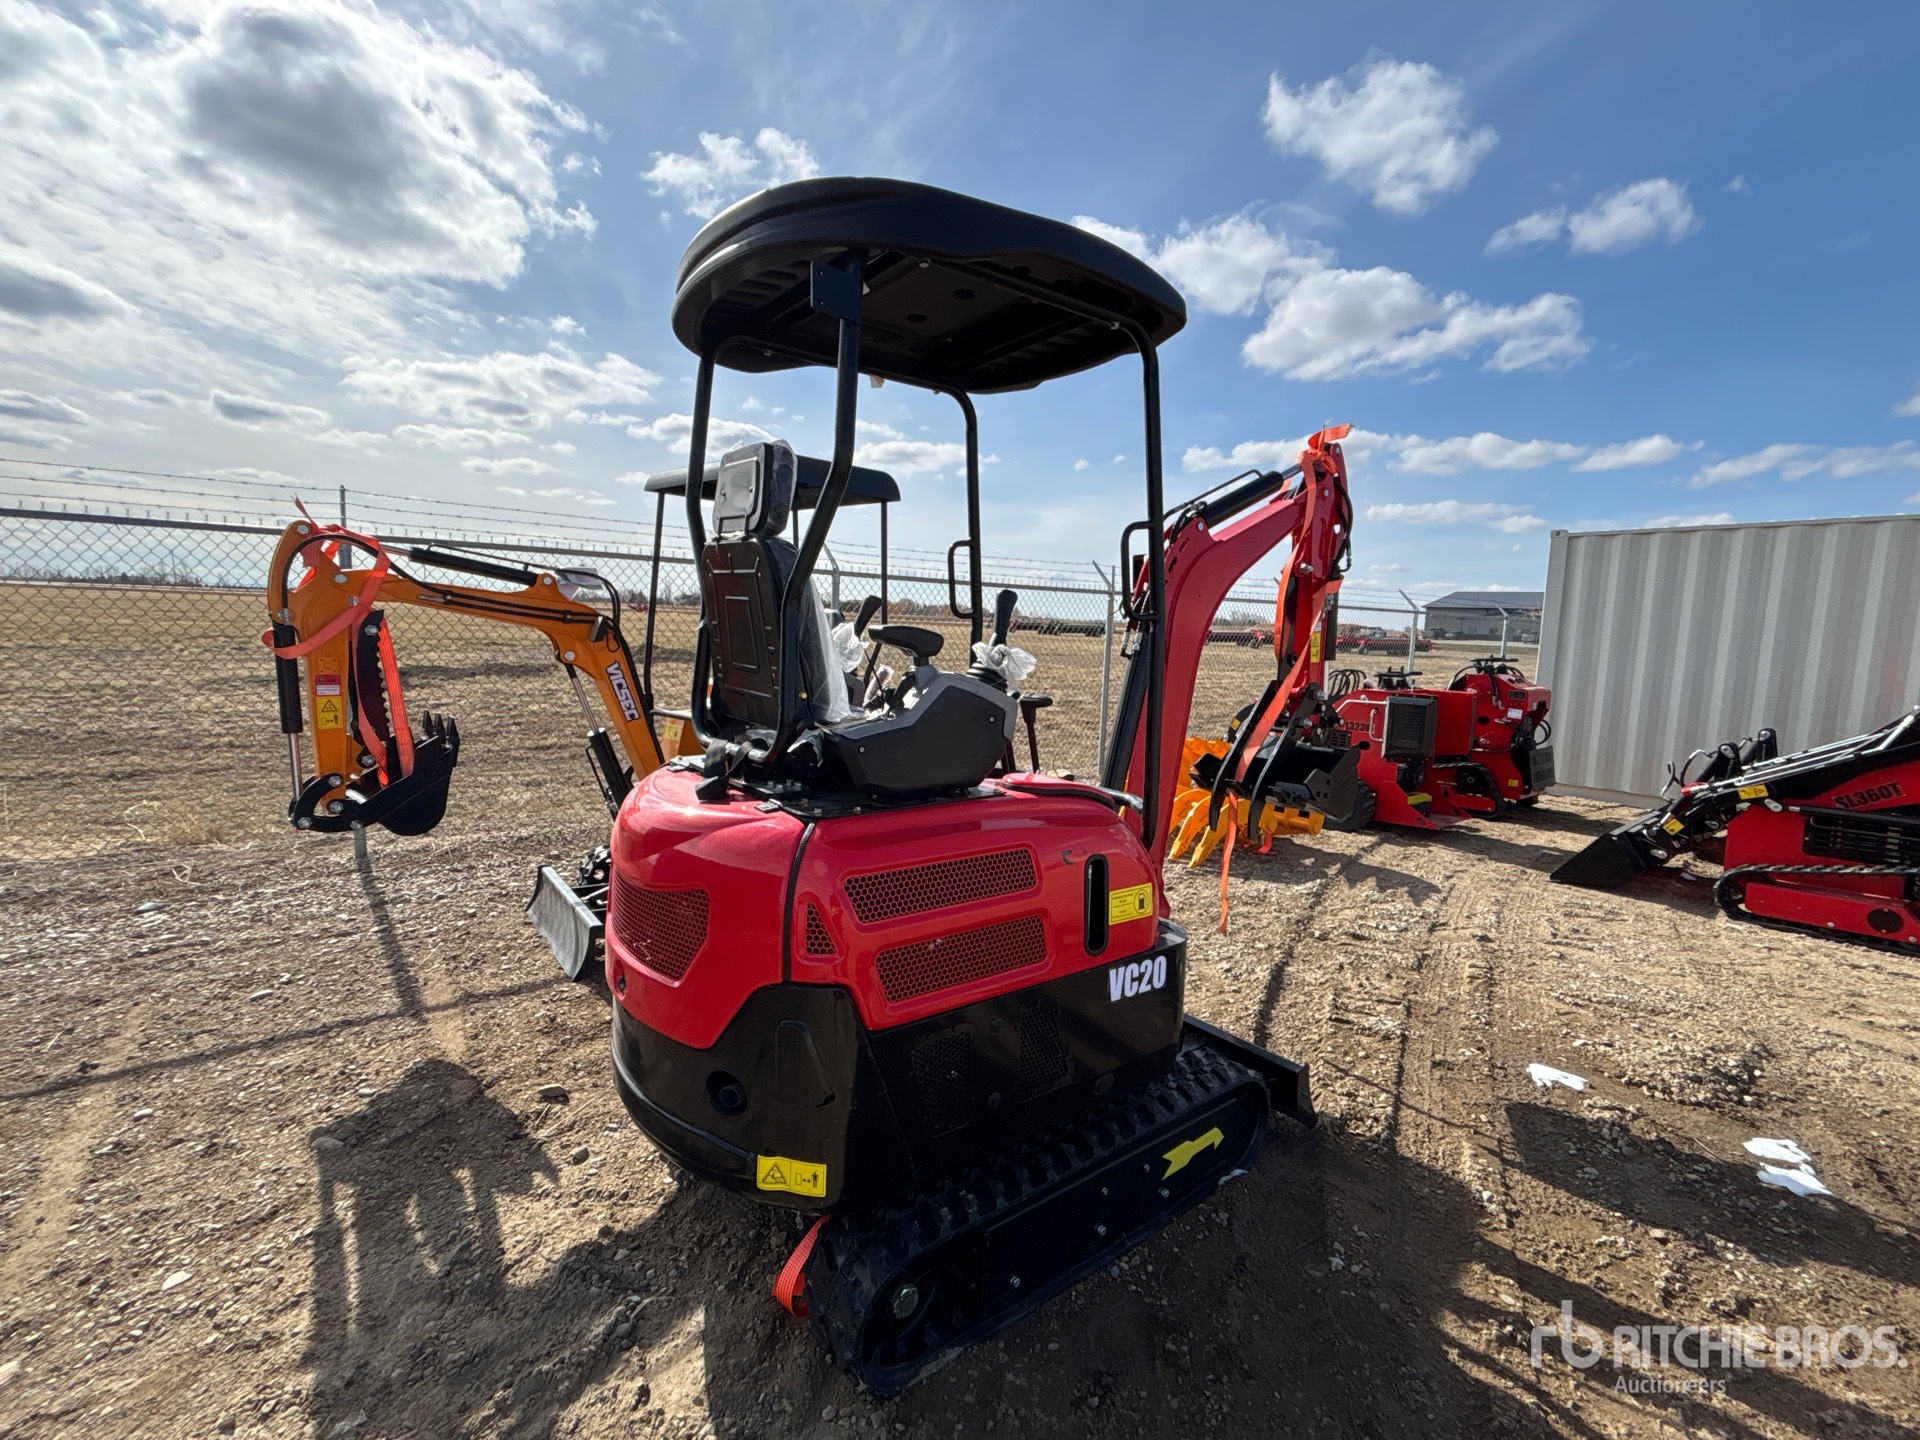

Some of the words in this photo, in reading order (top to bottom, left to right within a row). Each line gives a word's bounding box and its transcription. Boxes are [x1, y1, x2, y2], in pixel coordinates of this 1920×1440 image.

[605, 660, 641, 722] VICSEC
[1834, 782, 1902, 808] SL360T
[1108, 955, 1167, 1002] VC20
